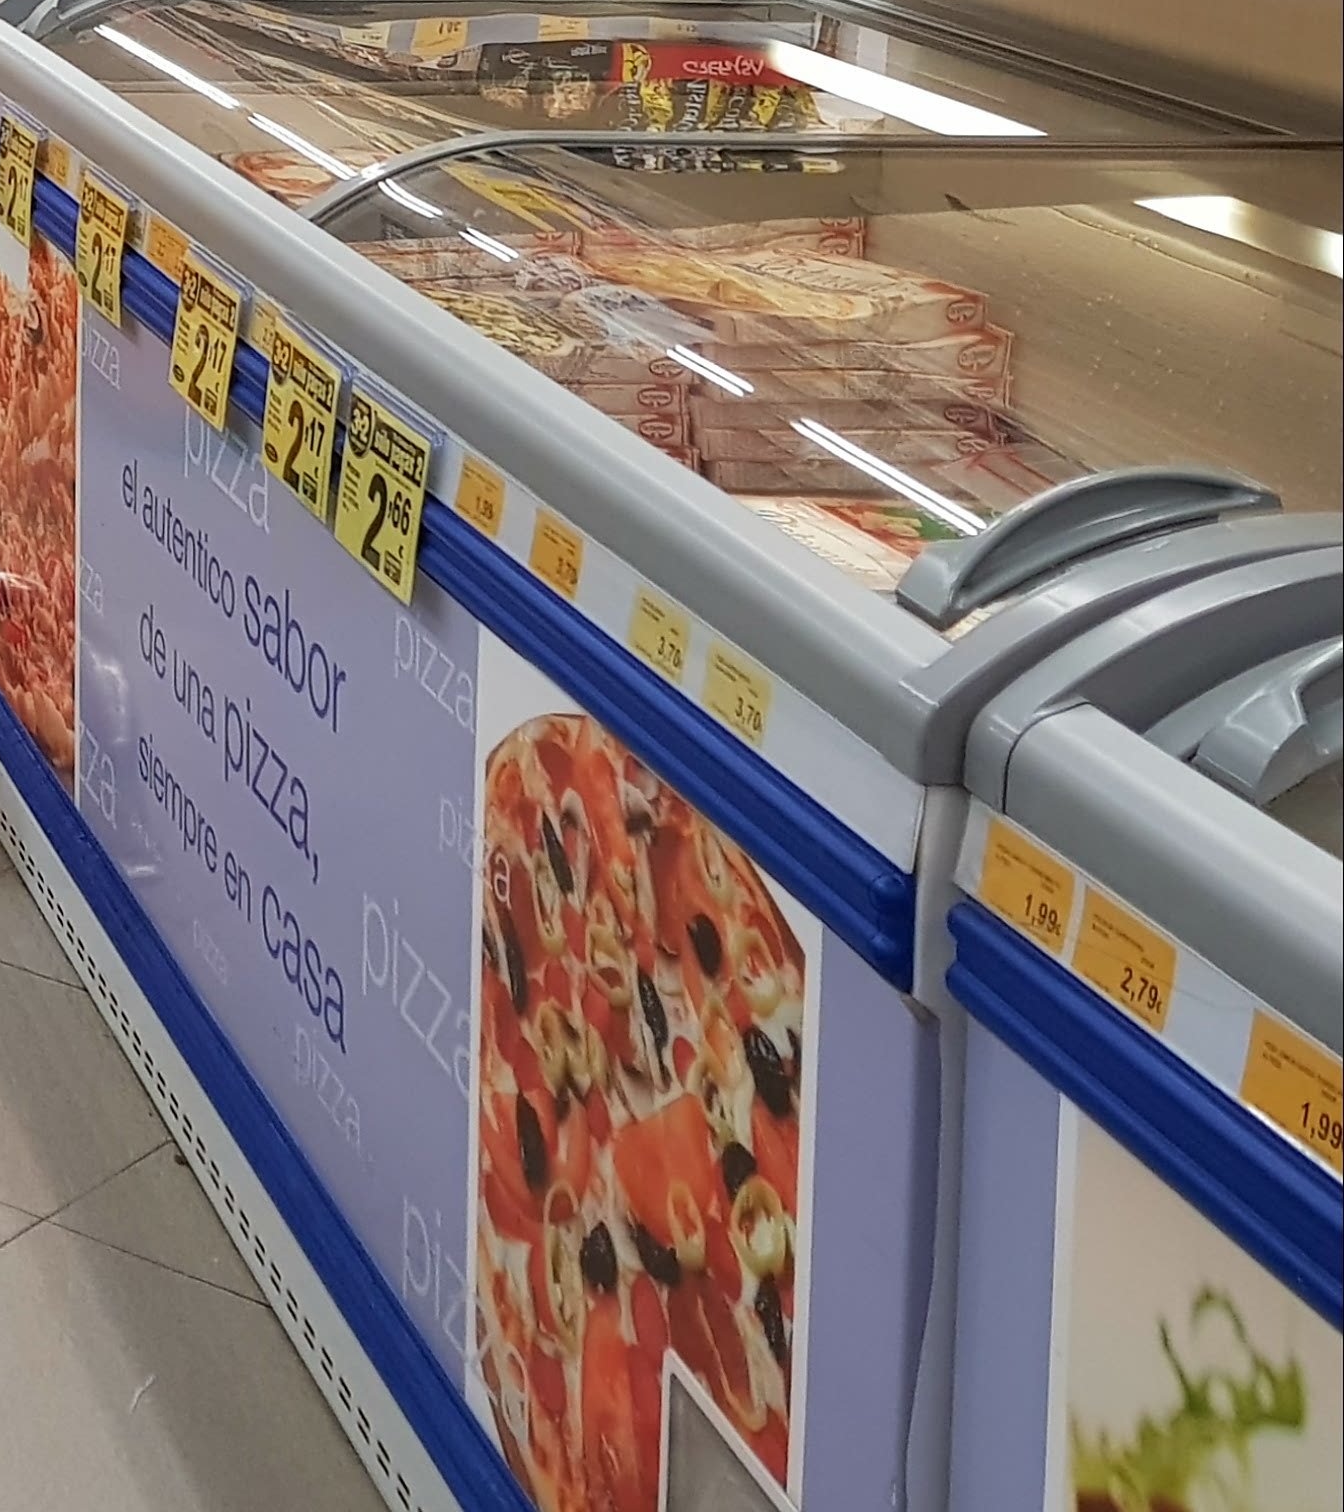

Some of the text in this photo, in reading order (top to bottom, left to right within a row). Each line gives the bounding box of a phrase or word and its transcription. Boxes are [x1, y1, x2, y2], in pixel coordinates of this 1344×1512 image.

[122, 457, 348, 735] el autentico sabor
[139, 602, 320, 885] de una pizza,
[137, 732, 348, 1056] siempre en casa
